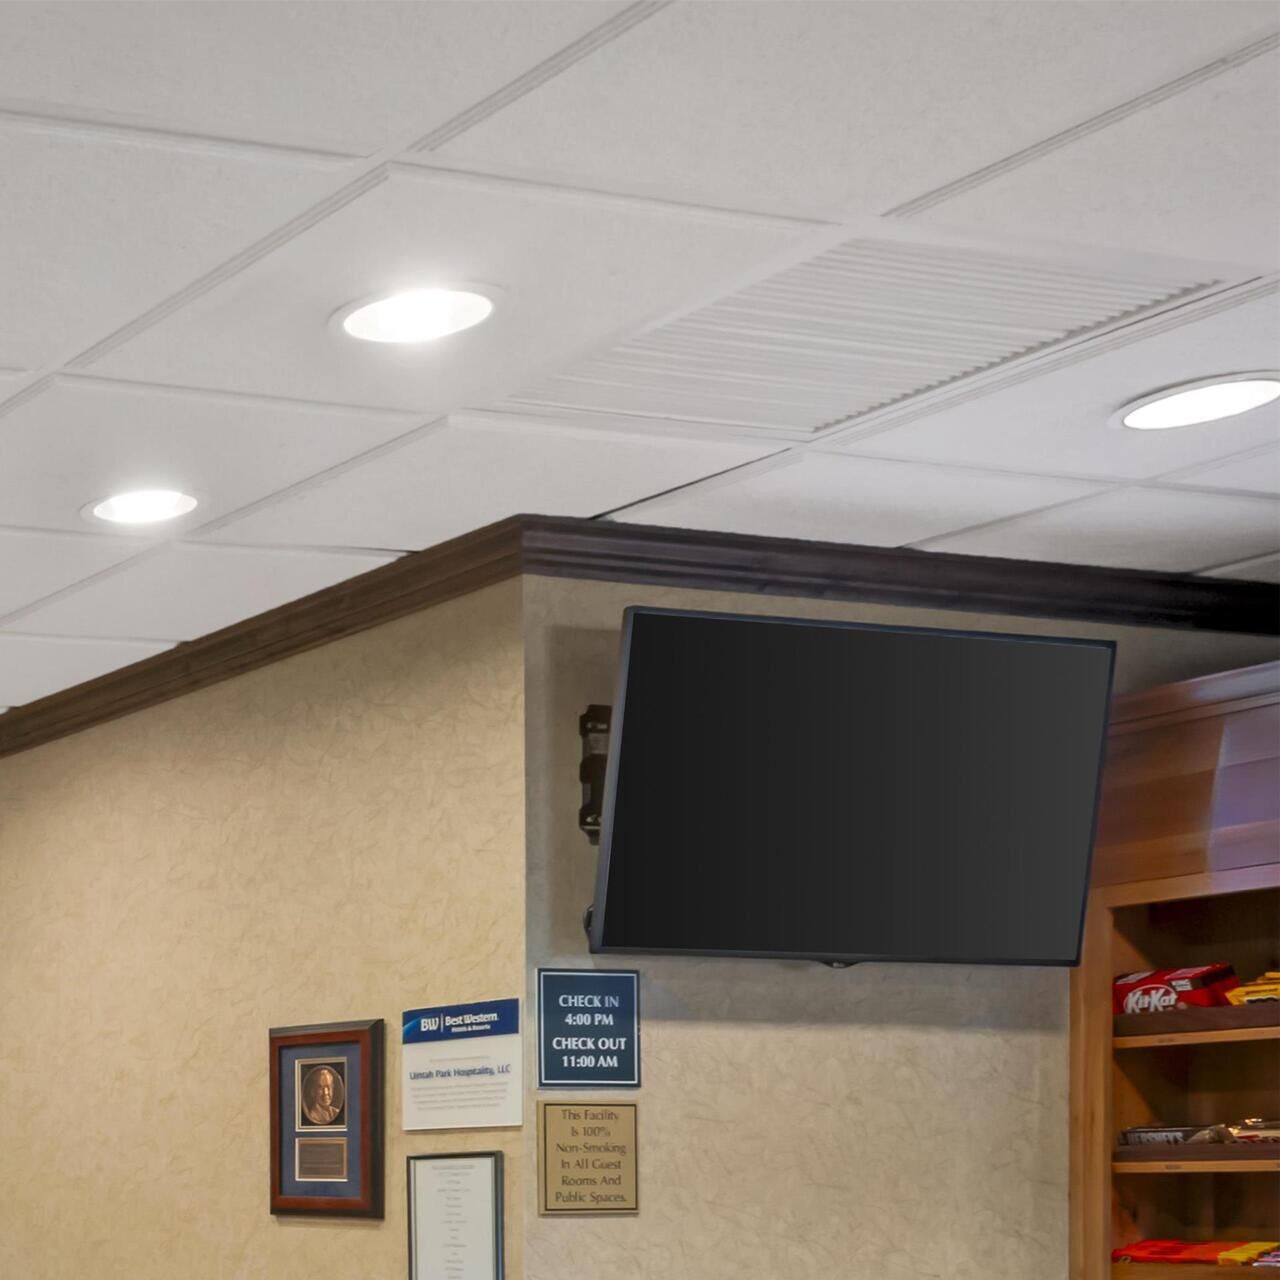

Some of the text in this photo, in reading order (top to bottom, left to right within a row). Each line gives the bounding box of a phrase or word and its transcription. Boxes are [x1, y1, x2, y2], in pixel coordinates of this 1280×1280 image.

[558, 994, 620, 1008] CHECK IN
[420, 1016, 440, 1032] BW
[445, 1012, 499, 1026] Best Western
[564, 1013, 614, 1025] 4:00 PM
[552, 1037, 627, 1050] CHECK OUT
[561, 1055, 619, 1068] 11:00 AM
[435, 1068, 452, 1079] Park
[497, 1063, 512, 1074] LLC
[561, 1109, 619, 1121] This Facility
[570, 1126, 611, 1137] Is 100%
[556, 1142, 627, 1156] Non-Smoking
[561, 1158, 622, 1170] In All Guest
[561, 1174, 622, 1186] Rooms And
[555, 1191, 587, 1202] Public
